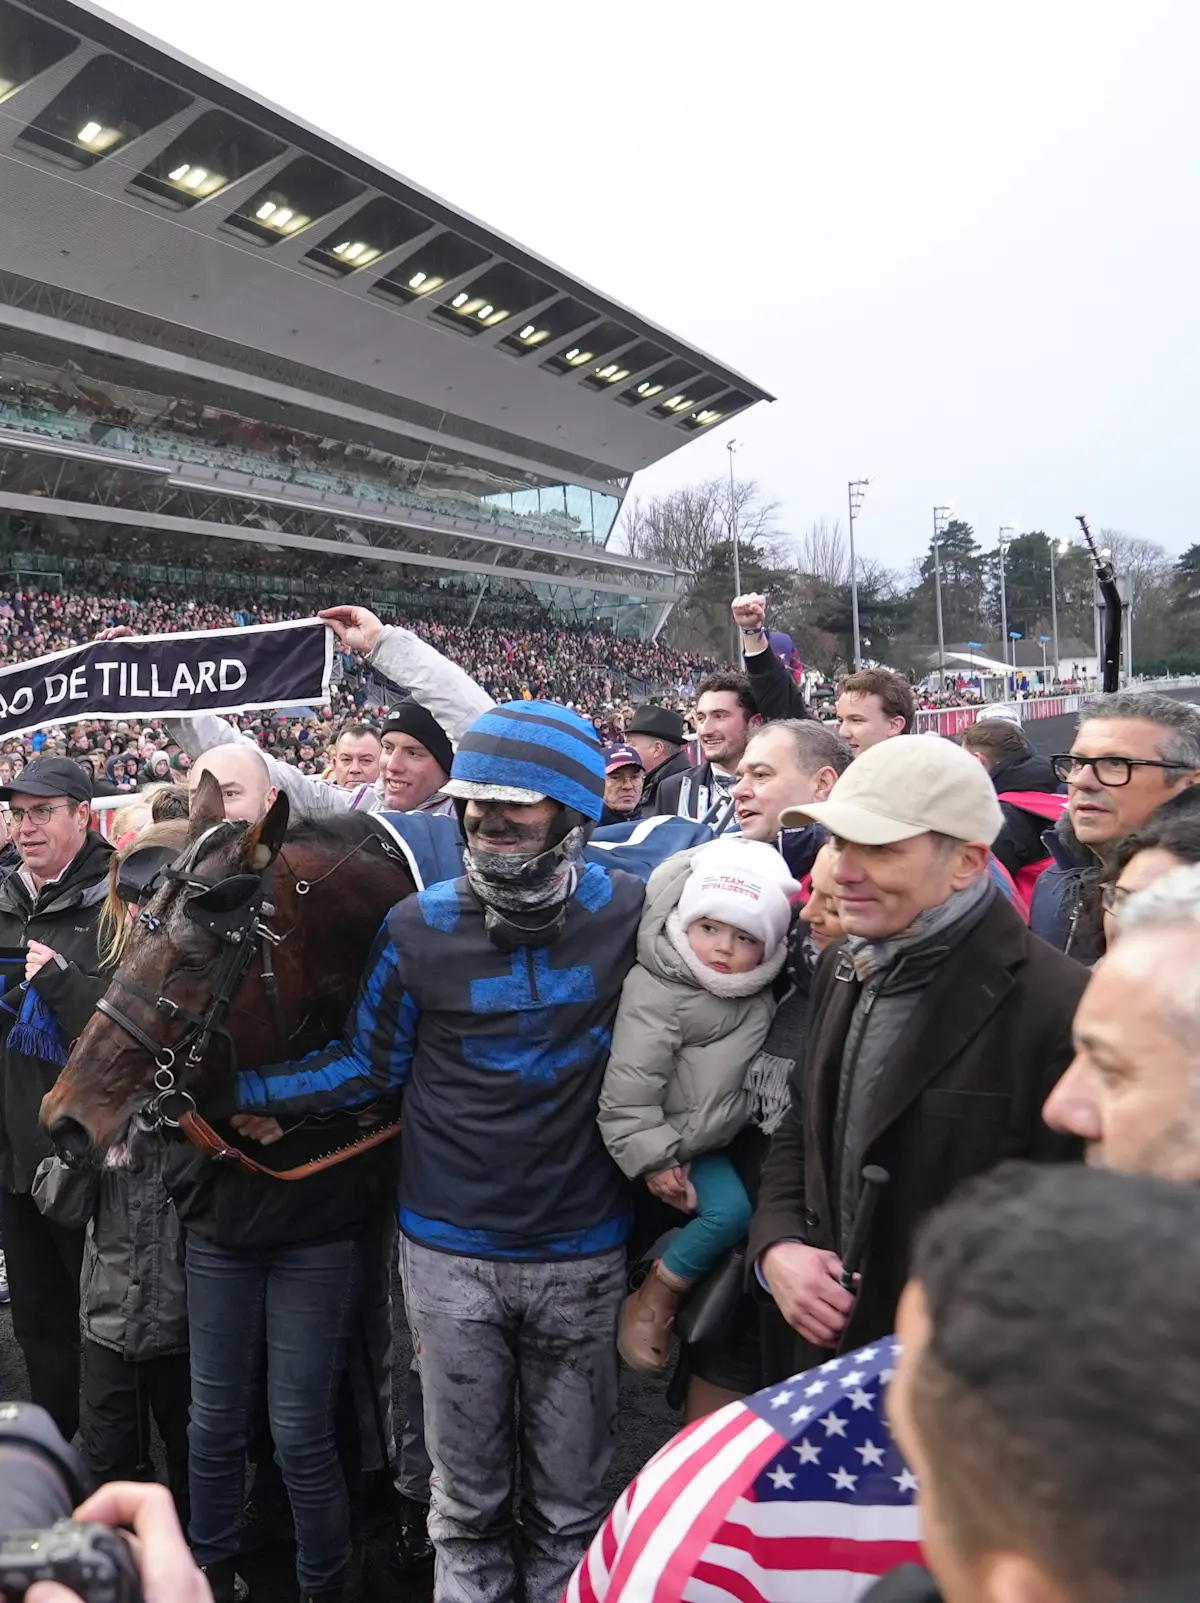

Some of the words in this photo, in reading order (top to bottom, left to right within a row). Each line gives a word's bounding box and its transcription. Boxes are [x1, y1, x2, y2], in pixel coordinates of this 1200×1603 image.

[44, 665, 88, 705] DE
[94, 658, 248, 698] TILLARD
[720, 876, 745, 885] TEAM
